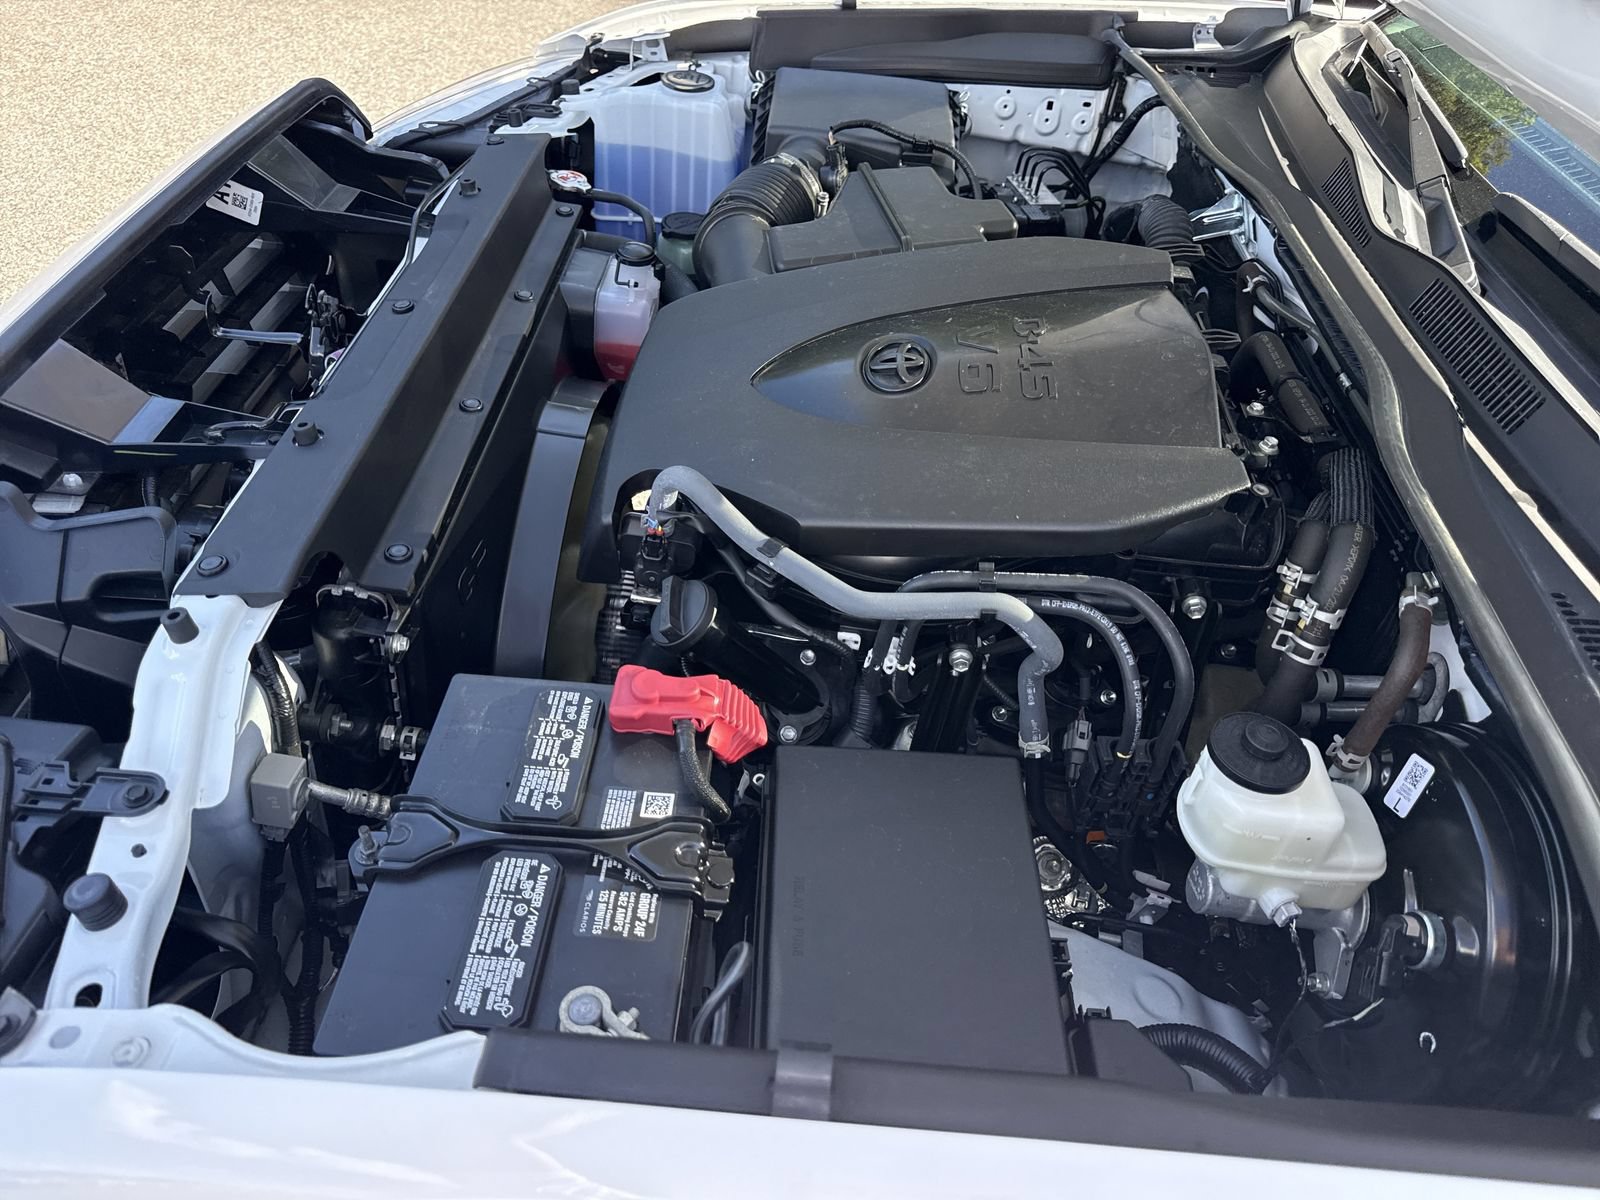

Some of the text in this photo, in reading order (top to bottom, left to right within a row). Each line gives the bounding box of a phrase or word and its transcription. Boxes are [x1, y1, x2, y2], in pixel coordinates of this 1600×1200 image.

[955, 323, 1002, 395] V6
[570, 705, 591, 758] DANGER/POISON
[520, 875, 548, 946] DANGER/POISON
[580, 902, 591, 932] CLARIOS
[592, 889, 609, 934] 125 MINUTES
[613, 892, 628, 932] 582 AMPS
[633, 893, 651, 937] GROUP 24F
